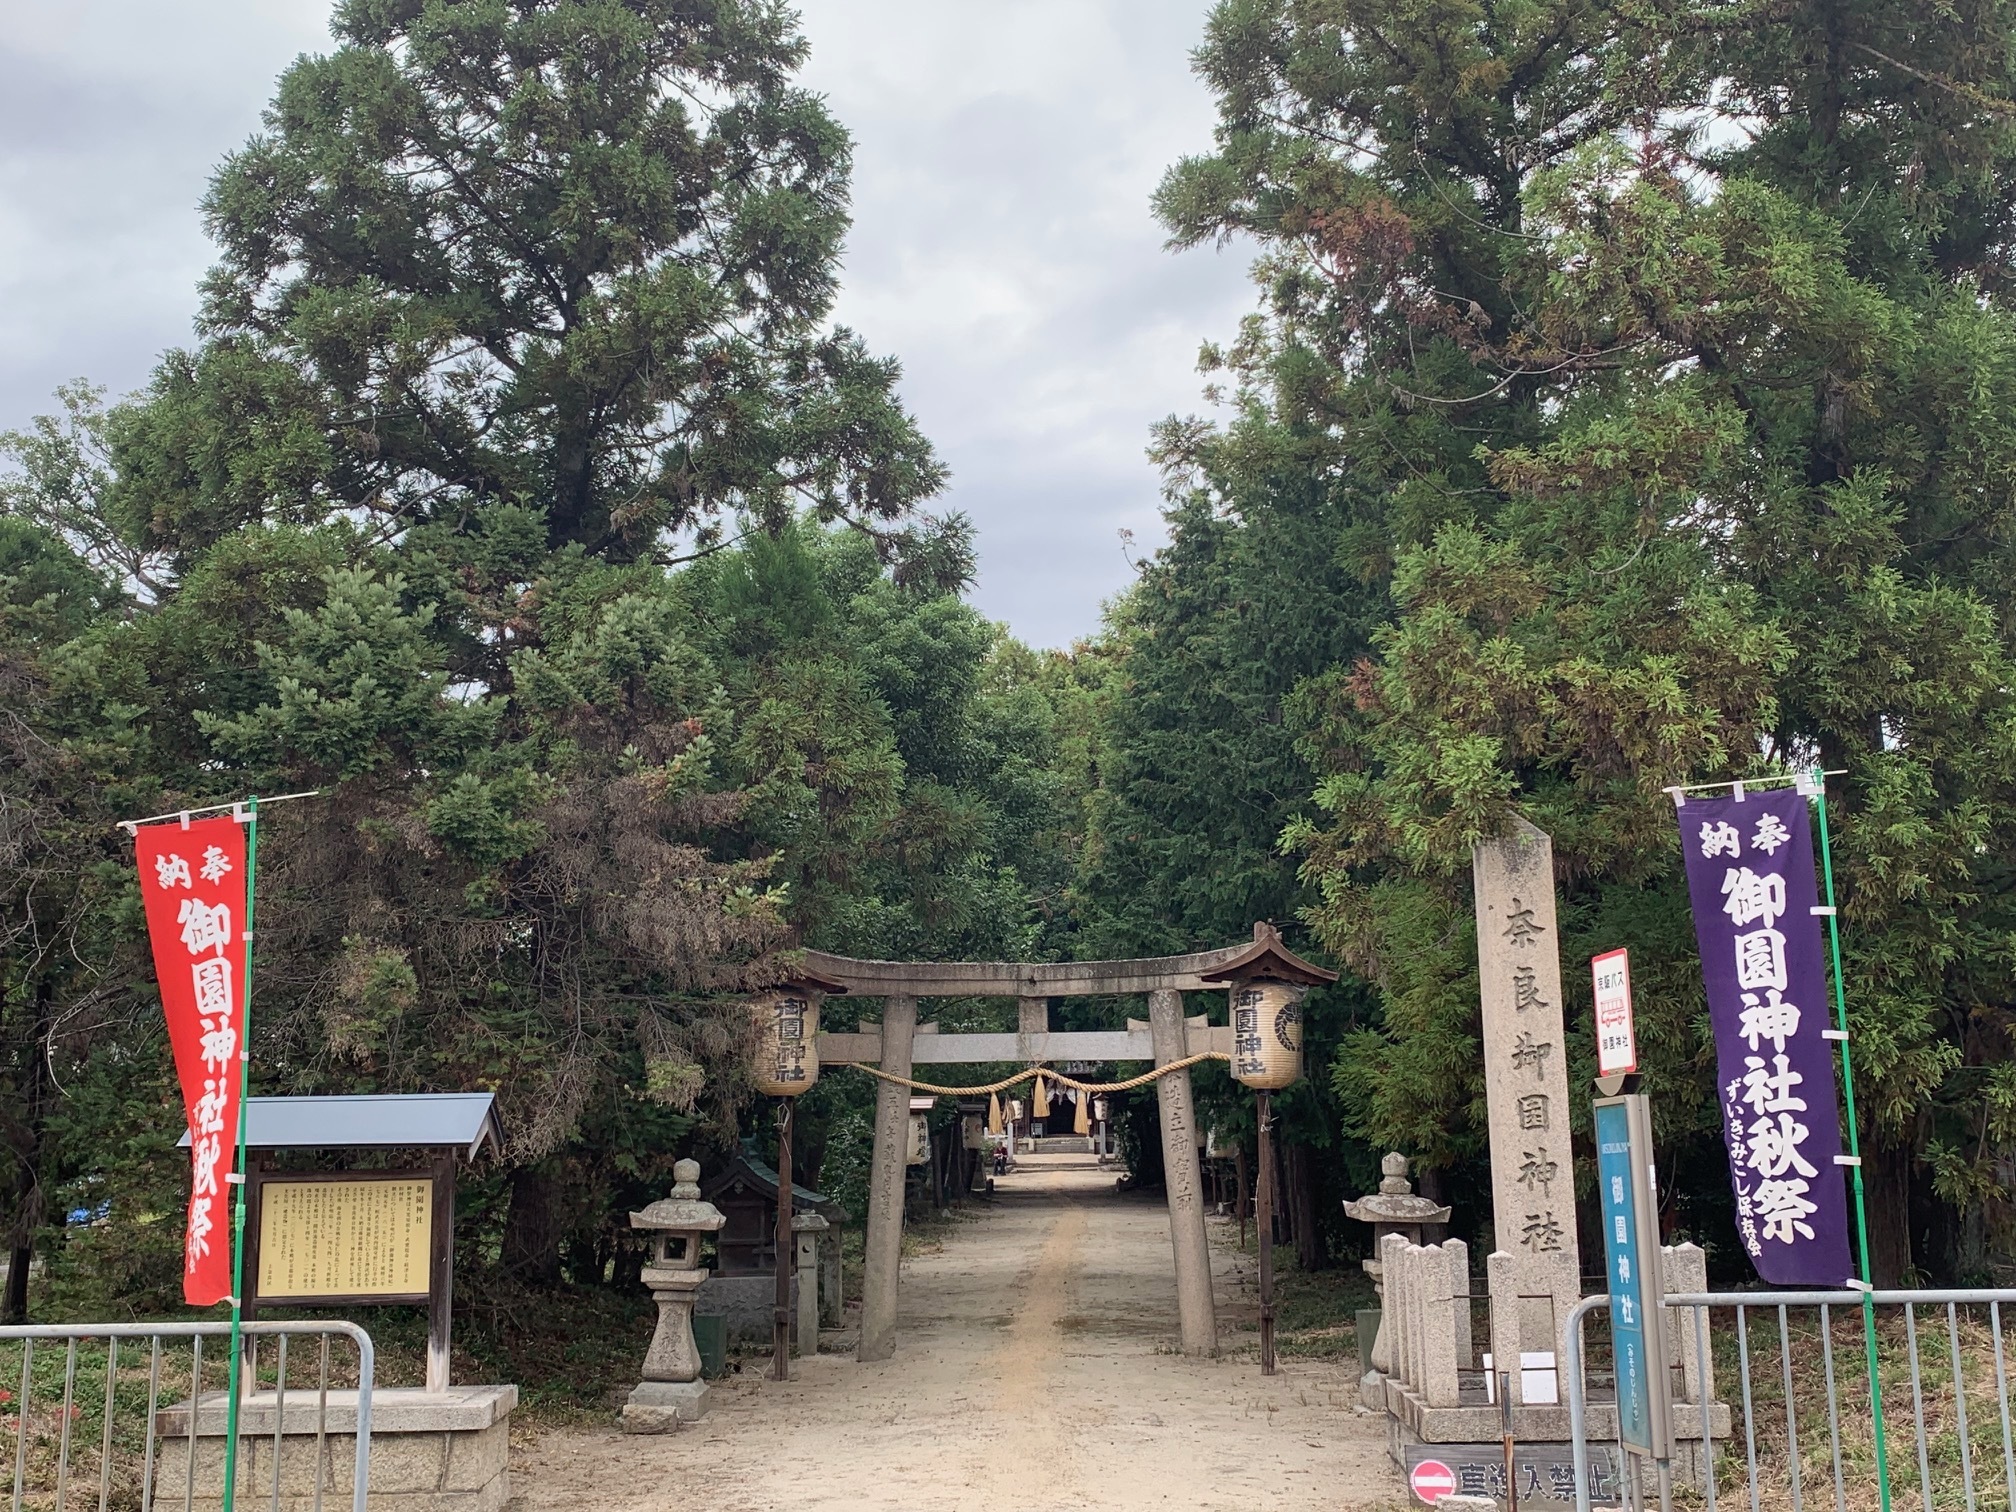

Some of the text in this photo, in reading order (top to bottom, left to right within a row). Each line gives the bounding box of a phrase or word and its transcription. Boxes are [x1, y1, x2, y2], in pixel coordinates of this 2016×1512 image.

[774, 997, 808, 1083] 御園神社
[1232, 989, 1266, 1076] 御園神社
[1721, 866, 1819, 1245] 御園神社秋祭
[1724, 1077, 1763, 1258] ずいきみこし保存会
[1611, 1175, 1635, 1324] 御園神社
[1458, 1462, 1615, 1503] 車進入禁止
